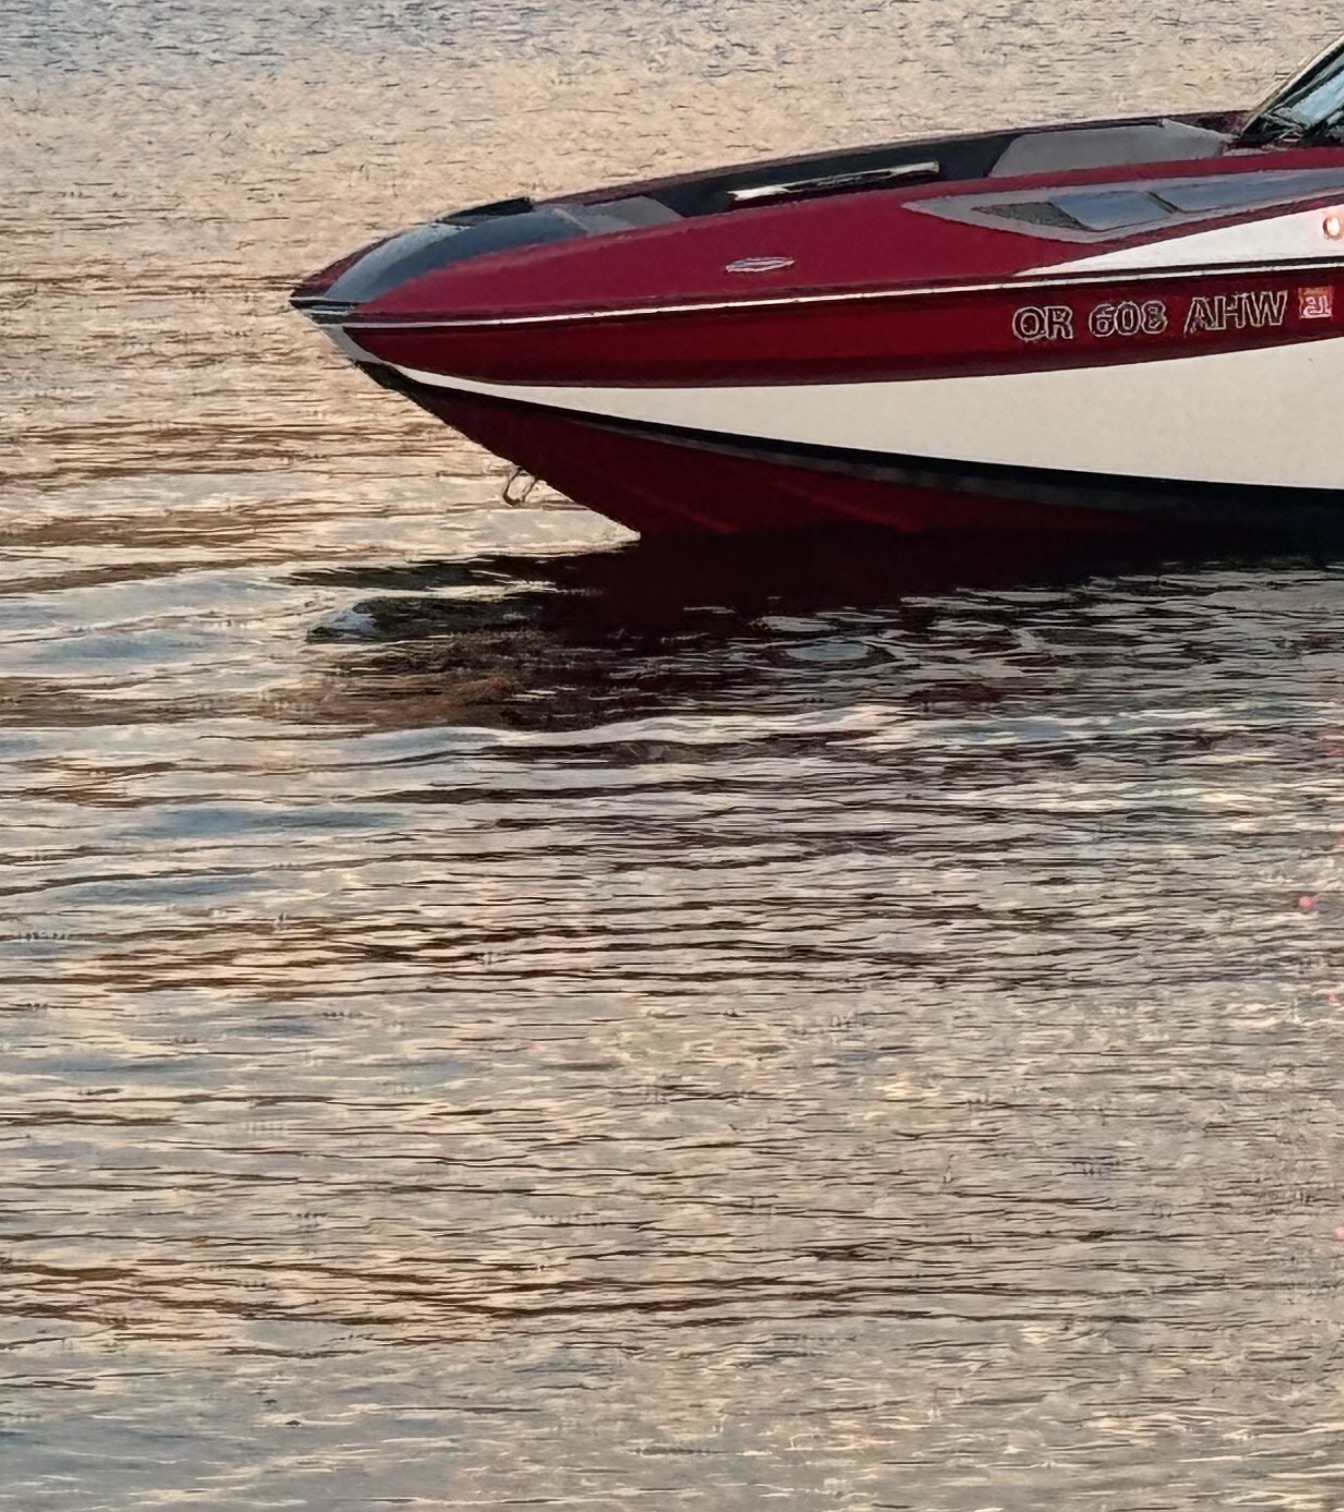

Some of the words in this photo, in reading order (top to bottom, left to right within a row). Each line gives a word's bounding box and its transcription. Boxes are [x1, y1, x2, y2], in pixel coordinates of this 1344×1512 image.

[1012, 306, 1073, 340] OR
[1088, 300, 1168, 338] 608
[1184, 290, 1288, 337] AHW
